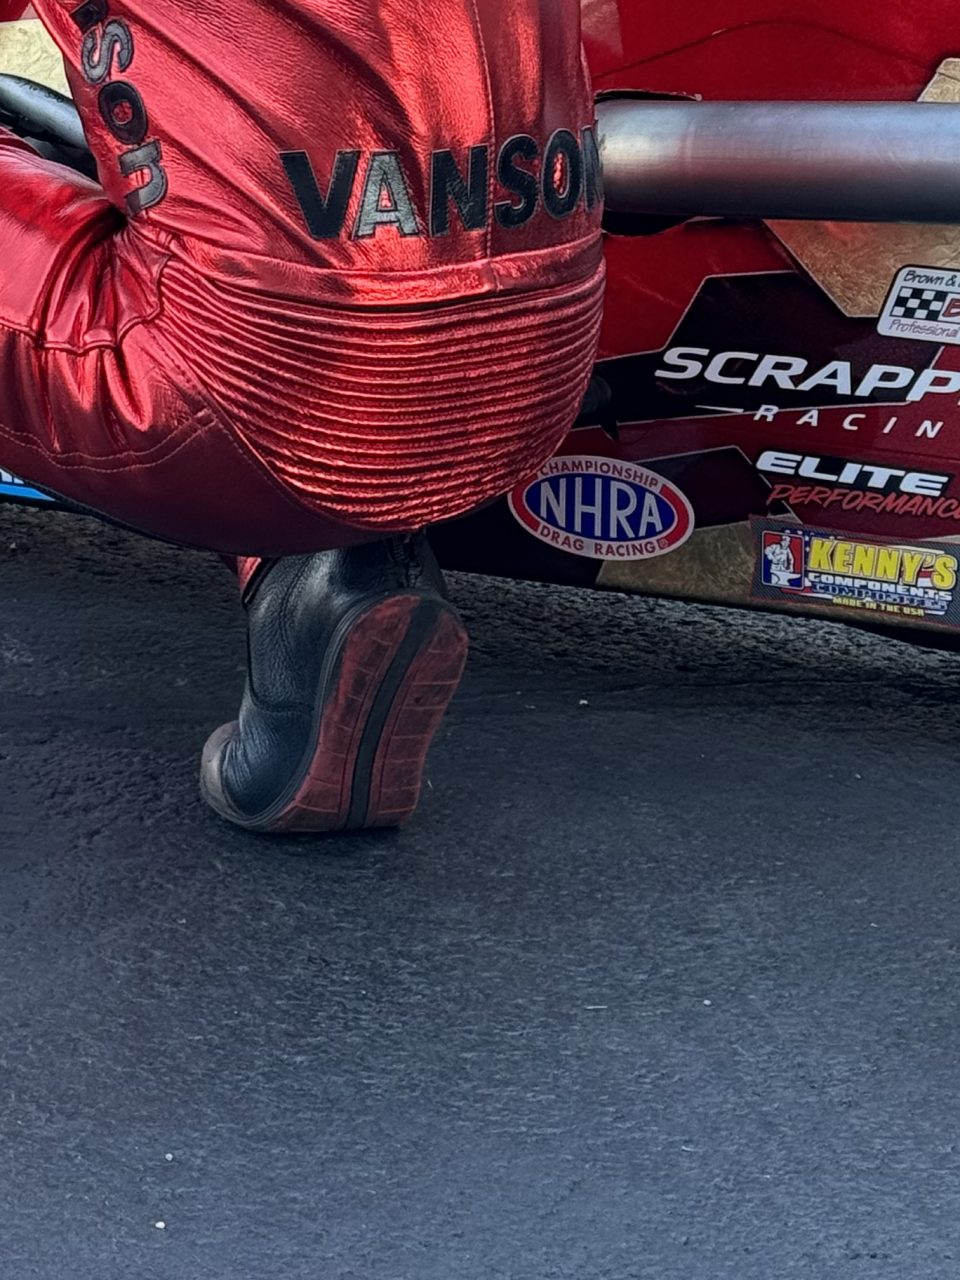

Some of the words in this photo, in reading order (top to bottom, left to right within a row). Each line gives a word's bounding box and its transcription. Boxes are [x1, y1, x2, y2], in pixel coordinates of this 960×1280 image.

[903, 270, 945, 286] Brown
[654, 346, 960, 402] SCRAPP
[541, 460, 659, 489] CHAMPIONSHIP
[755, 450, 949, 497] ELITE
[540, 476, 663, 539] NHRA
[766, 484, 960, 519] PERFORMANC
[540, 524, 585, 552] DRAG
[594, 541, 656, 557] RACING
[807, 537, 958, 590] KENNY'S
[808, 572, 953, 601] COMPONENTS
[832, 597, 862, 609] MADE
[865, 601, 877, 610] IN
[880, 602, 901, 614] THE
[903, 606, 925, 617] USA
